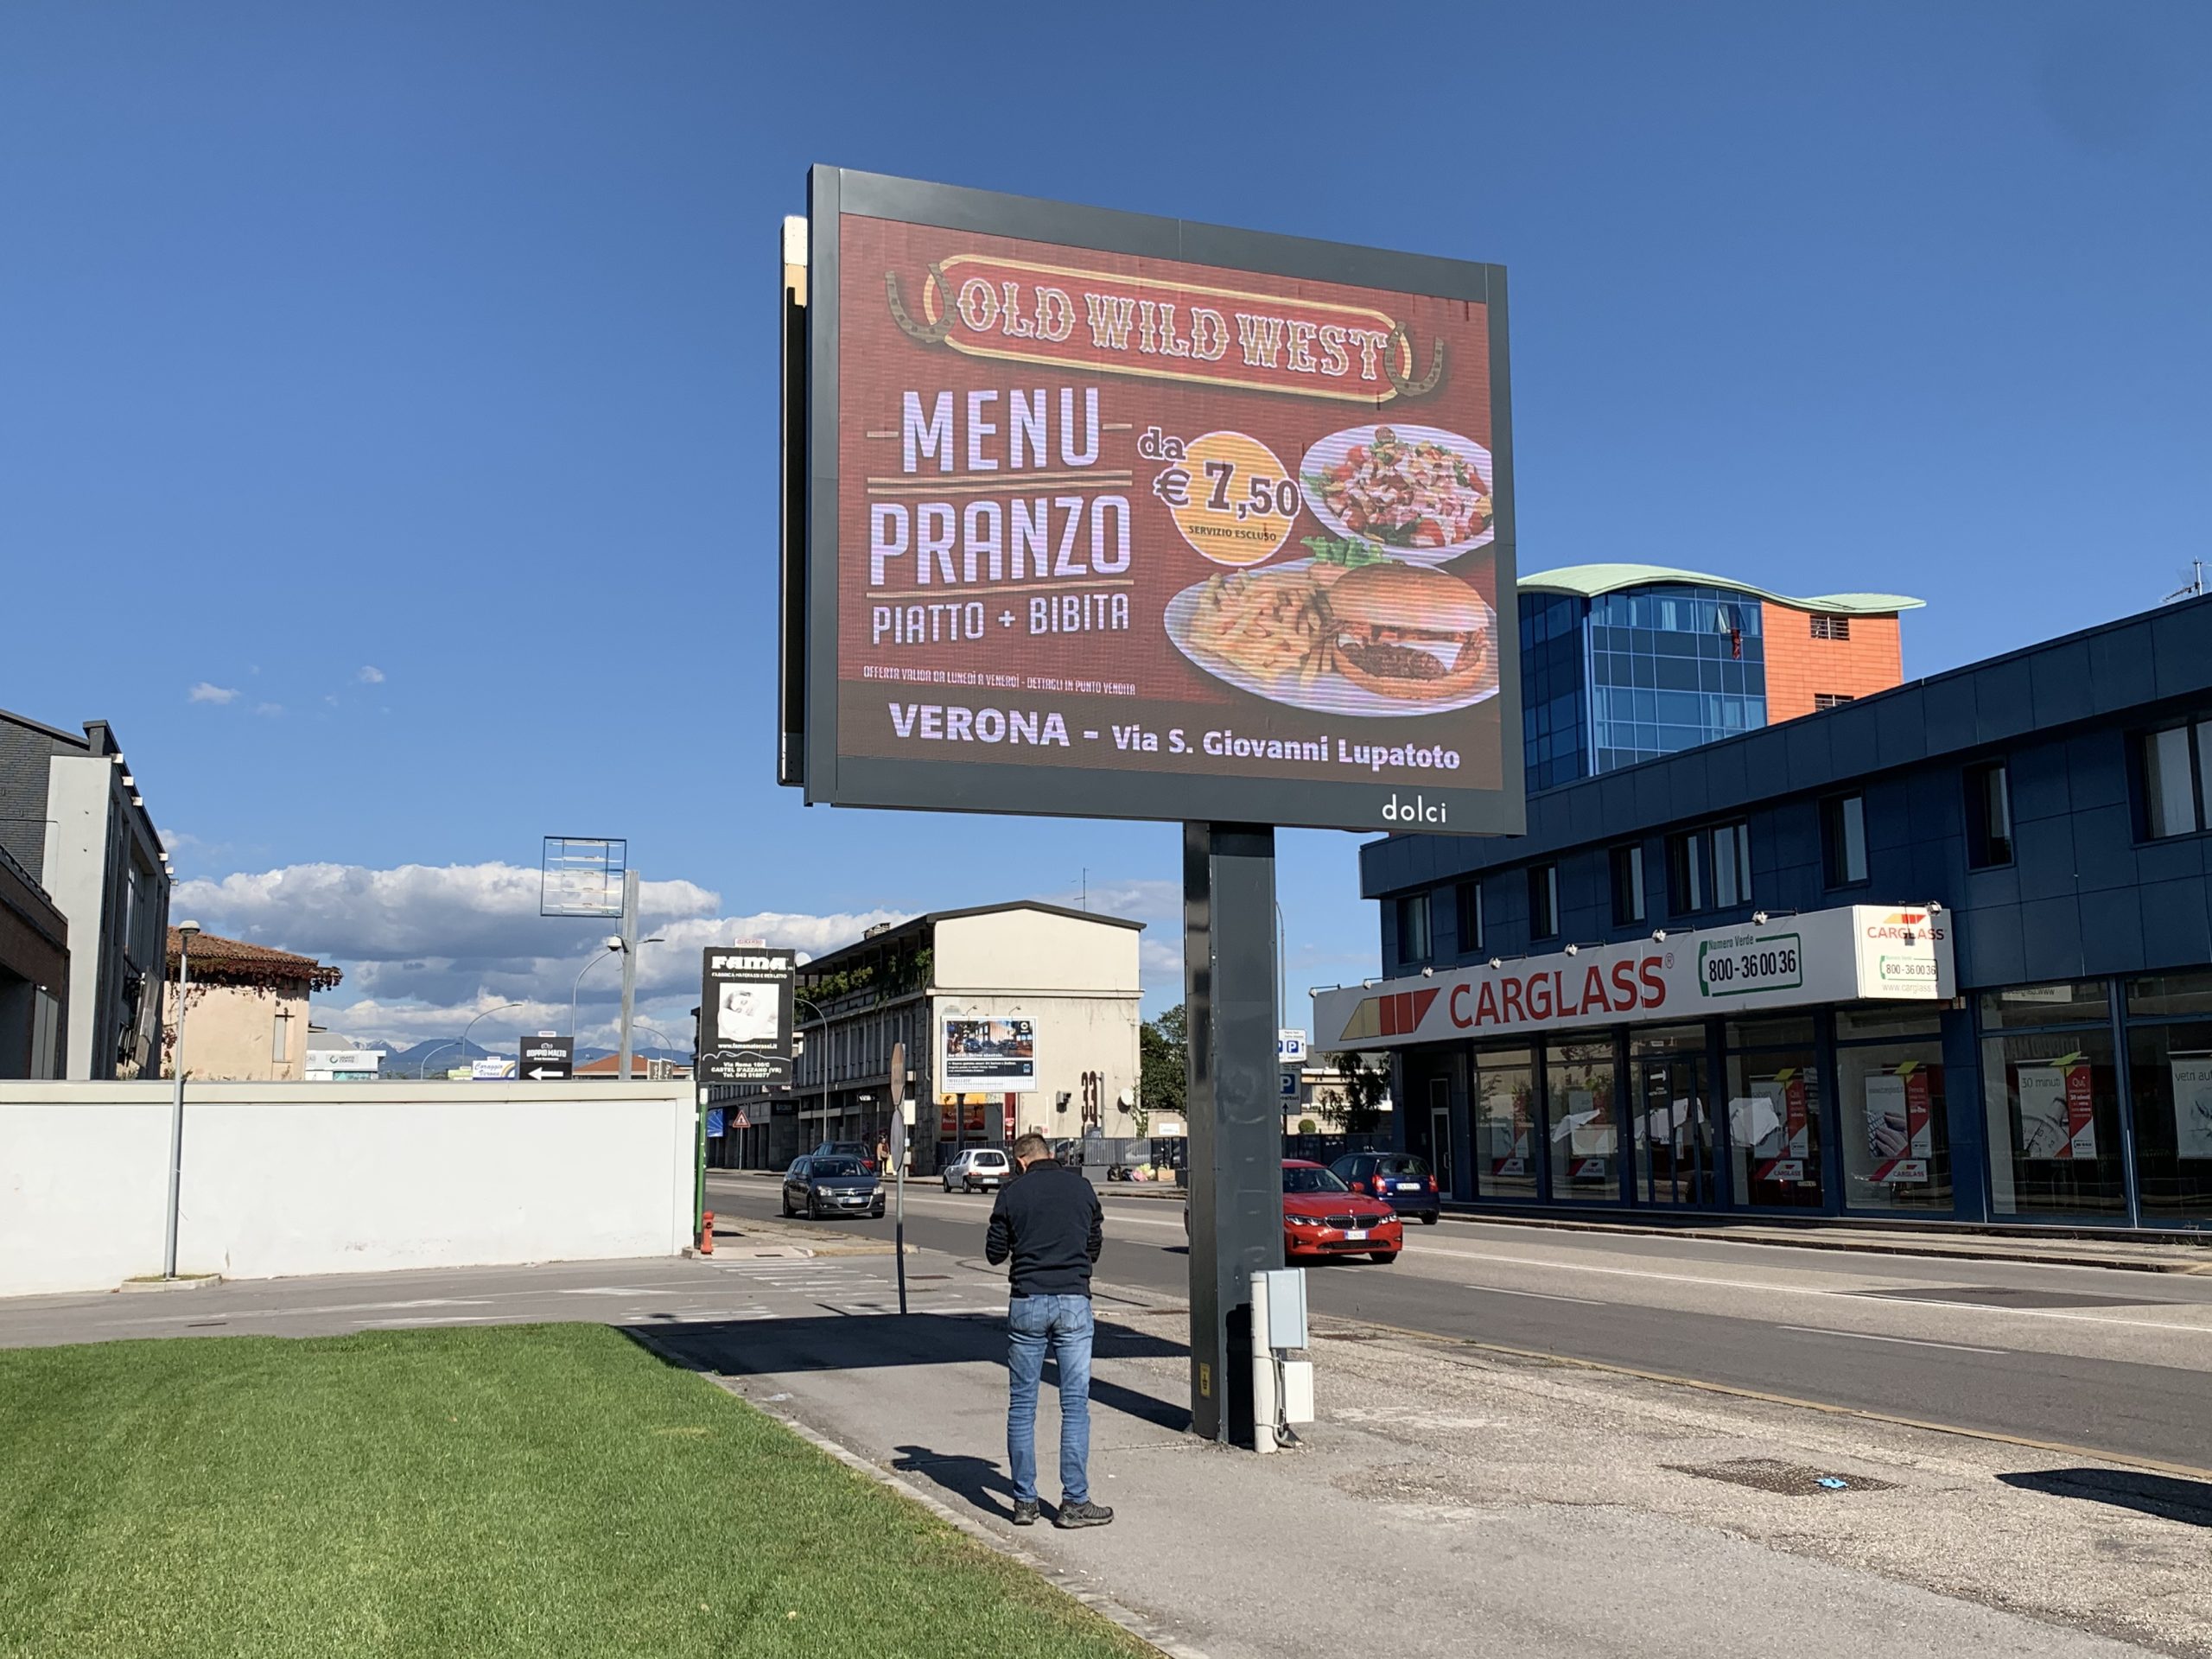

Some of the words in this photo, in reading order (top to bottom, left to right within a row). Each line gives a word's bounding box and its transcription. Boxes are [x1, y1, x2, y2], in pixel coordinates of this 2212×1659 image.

[957, 277, 1076, 342] OLD
[1084, 293, 1229, 361] WILD
[1235, 313, 1388, 381] WEST
[902, 387, 1100, 473] MENU
[1137, 426, 1186, 461] da
[1204, 460, 1301, 522] 7,50
[870, 494, 1131, 585] PRANZO
[1189, 525, 1232, 537] SERVIZIO
[1236, 531, 1277, 541] ESCLUSO
[873, 601, 984, 645] PIATTO
[999, 610, 1015, 626] +
[1030, 593, 1128, 634] BIBITA
[863, 665, 899, 679] OFFERTA
[901, 668, 931, 682] VALIDA
[933, 671, 945, 683] DA
[947, 671, 976, 685] LUNEDÌ
[977, 674, 984, 685] A
[985, 673, 1020, 688] VENERDÌ
[1027, 677, 1064, 691] DETTAGLI
[1065, 678, 1074, 691] IN
[1075, 680, 1102, 693] PUNTO
[1103, 682, 1135, 696] VENDITA
[888, 702, 1070, 747] VERONA
[1111, 724, 1158, 753] Via
[1168, 728, 1193, 754] S.
[1203, 729, 1329, 761] Giovanni
[1338, 739, 1461, 772] Lupatoto
[1382, 793, 1447, 823] dolci
[1708, 937, 1733, 950] Numero
[1734, 934, 1754, 948] Verde
[1867, 927, 1944, 940] CARGLASS
[2022, 1077, 2033, 1088] 30
